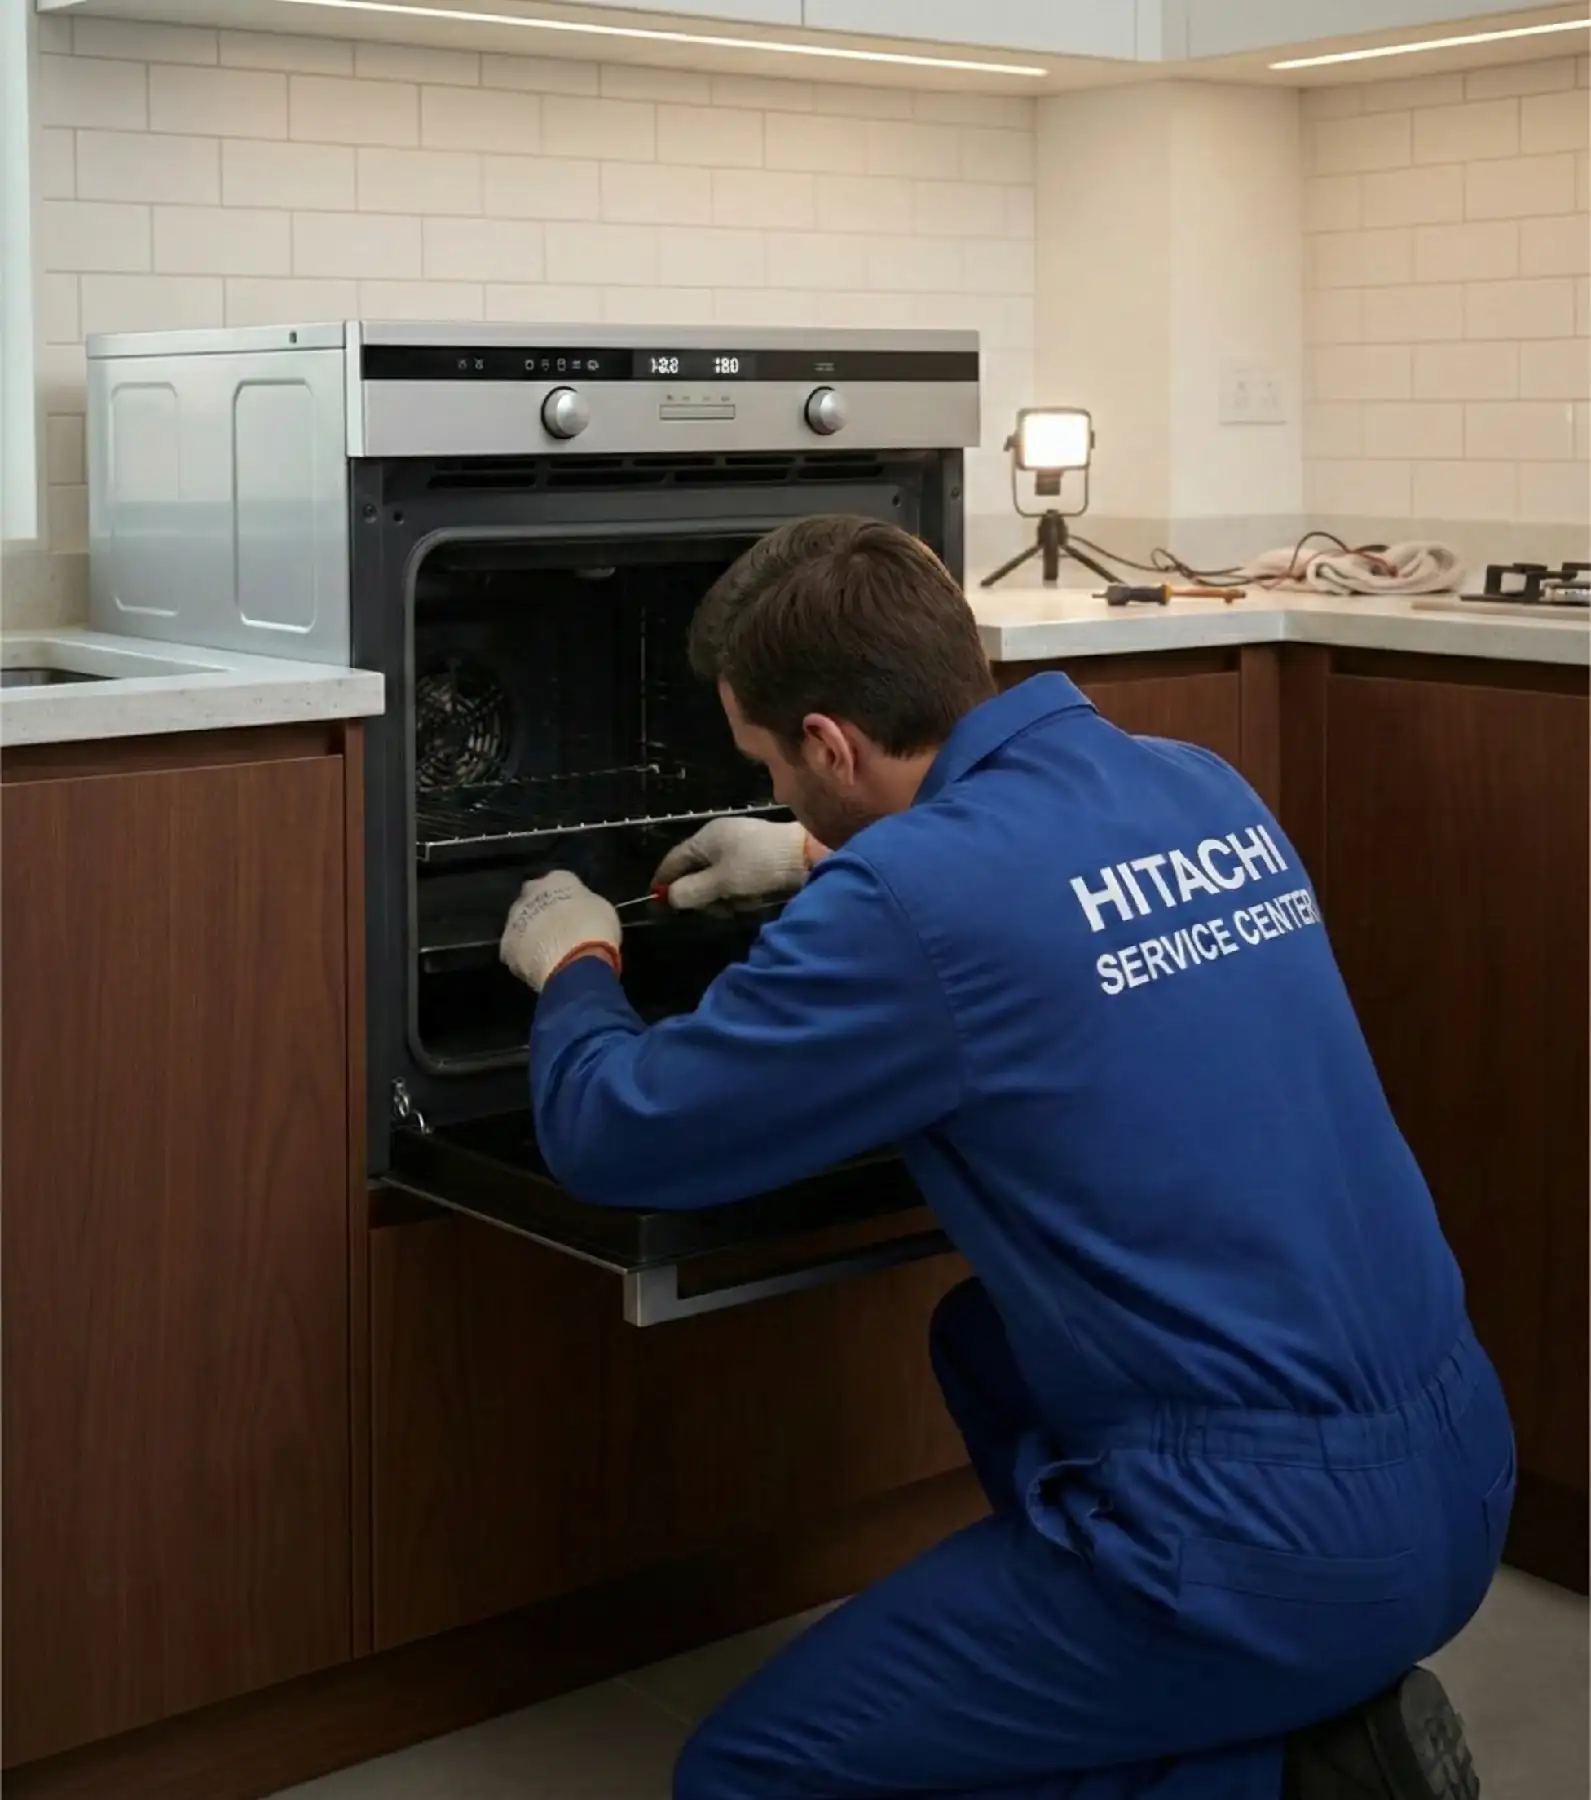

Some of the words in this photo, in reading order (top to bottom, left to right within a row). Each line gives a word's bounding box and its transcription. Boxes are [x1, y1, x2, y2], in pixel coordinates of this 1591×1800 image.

[1069, 824, 1289, 932] HITACHI
[1096, 918, 1240, 996] SERVICE
[1233, 888, 1323, 946] CENTER
